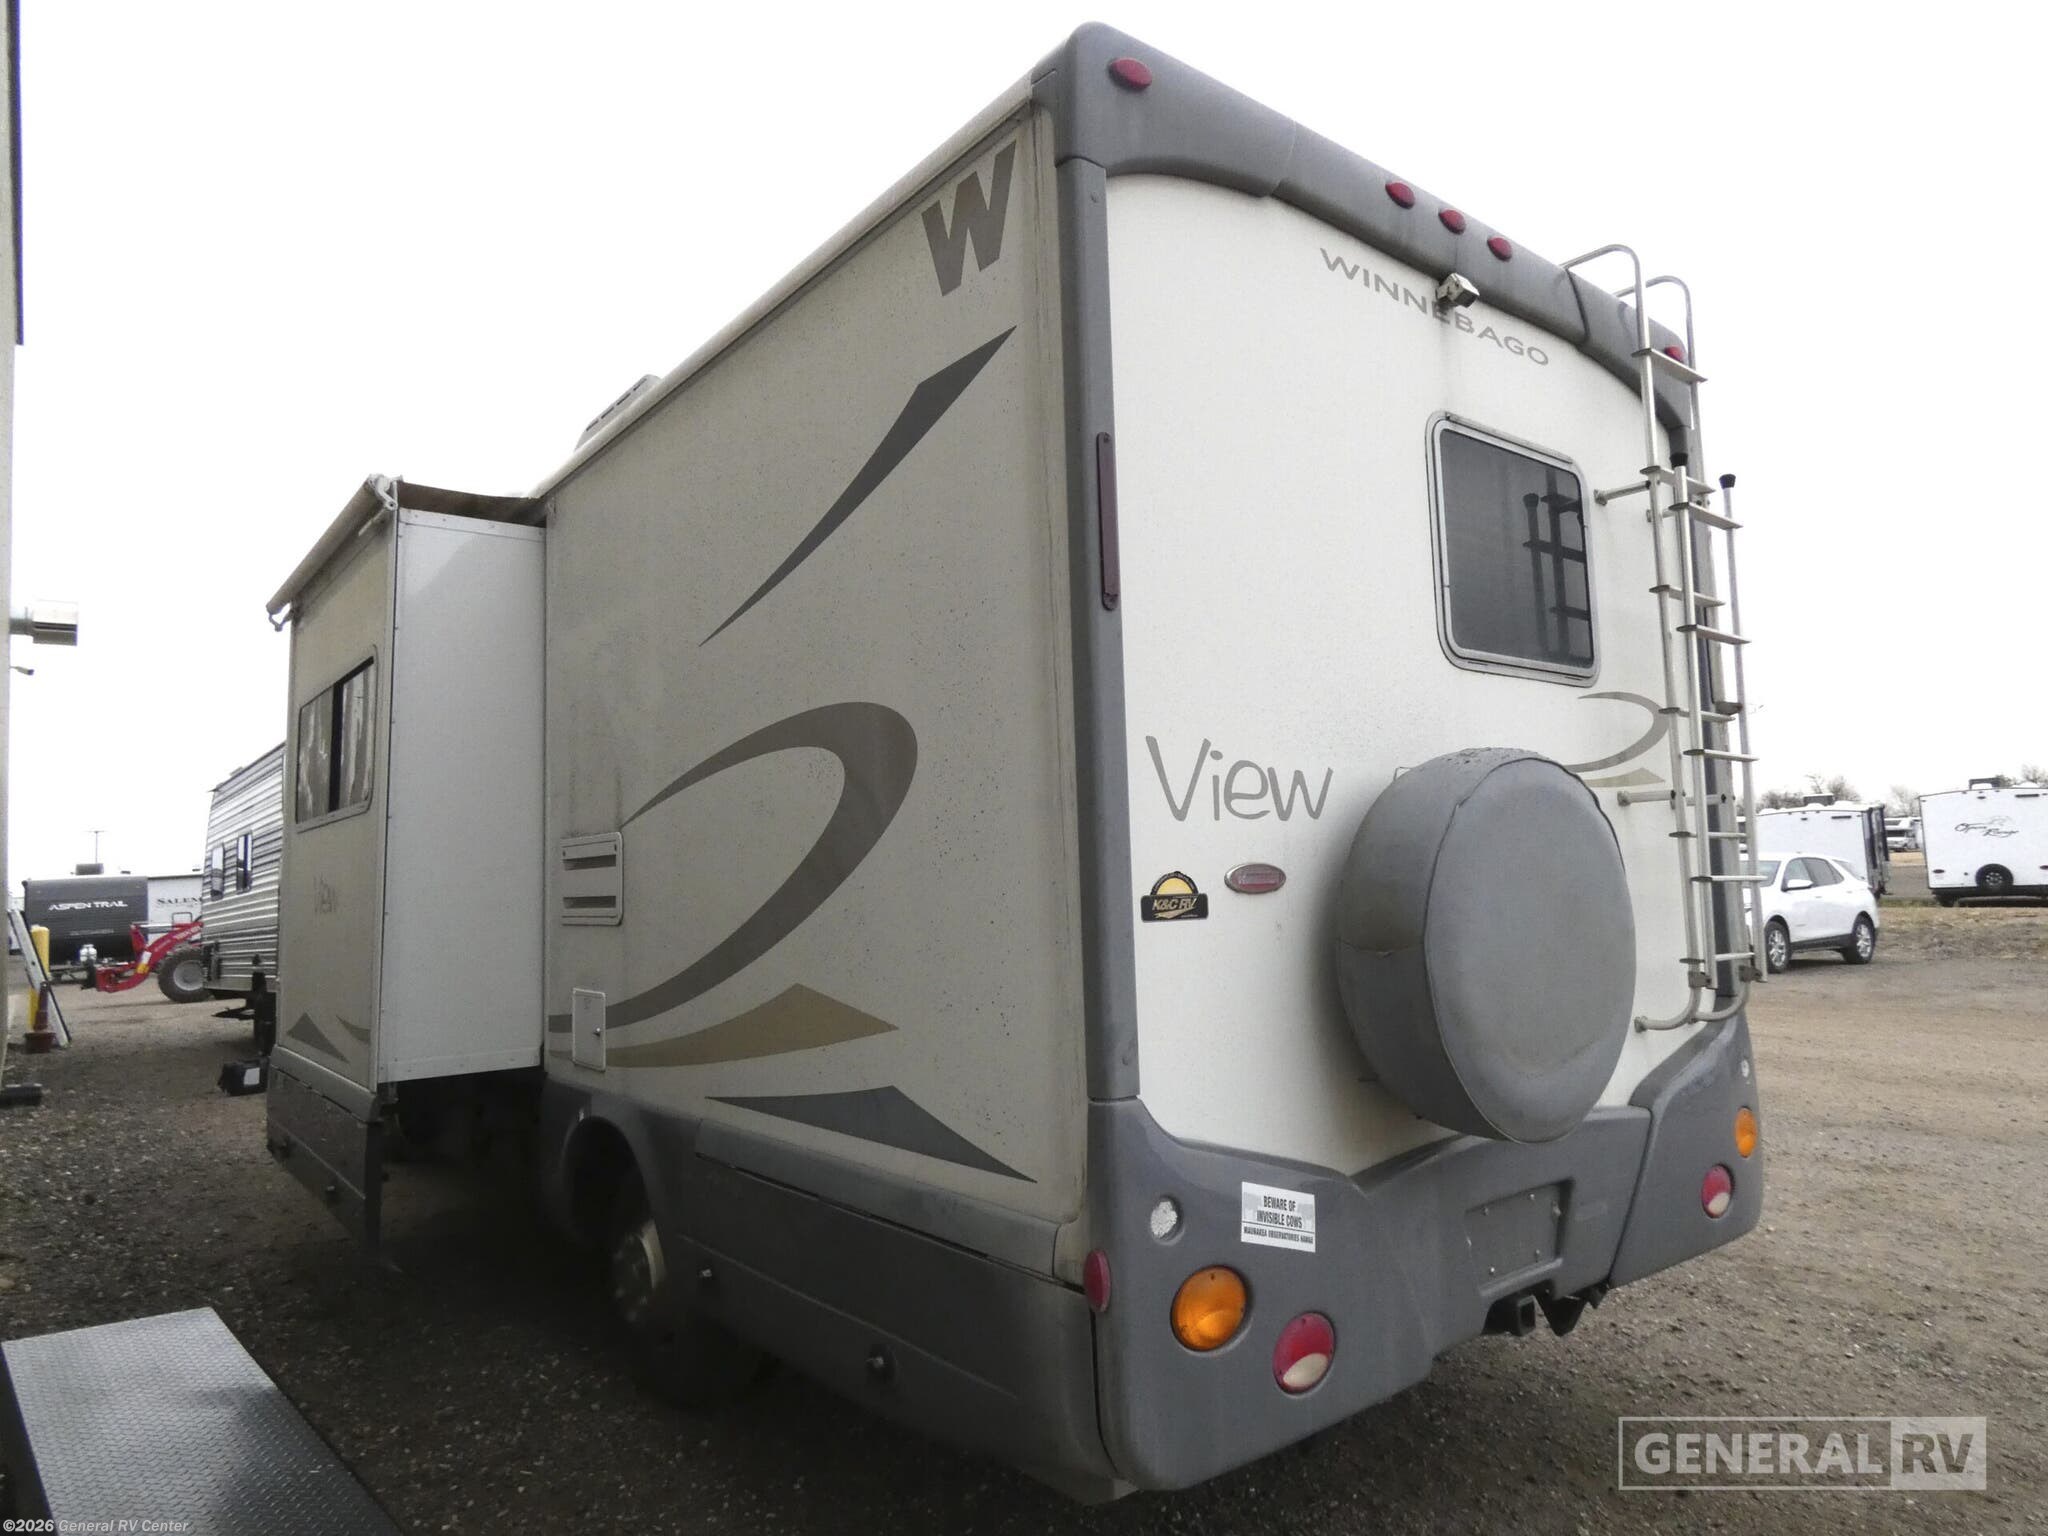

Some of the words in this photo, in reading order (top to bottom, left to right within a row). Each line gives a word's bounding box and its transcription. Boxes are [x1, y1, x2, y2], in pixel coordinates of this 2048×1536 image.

[921, 140, 1016, 297] W
[1319, 247, 1549, 366] WINNEBAGO
[1145, 735, 1333, 822] View
[48, 902, 91, 911] ASPEN
[92, 900, 128, 908] TRAIL
[1256, 1210, 1285, 1226] INVISIBLE
[1286, 1214, 1303, 1229] COWS
[1263, 1195, 1288, 1211] BEWARE
[1288, 1200, 1296, 1212] OF
